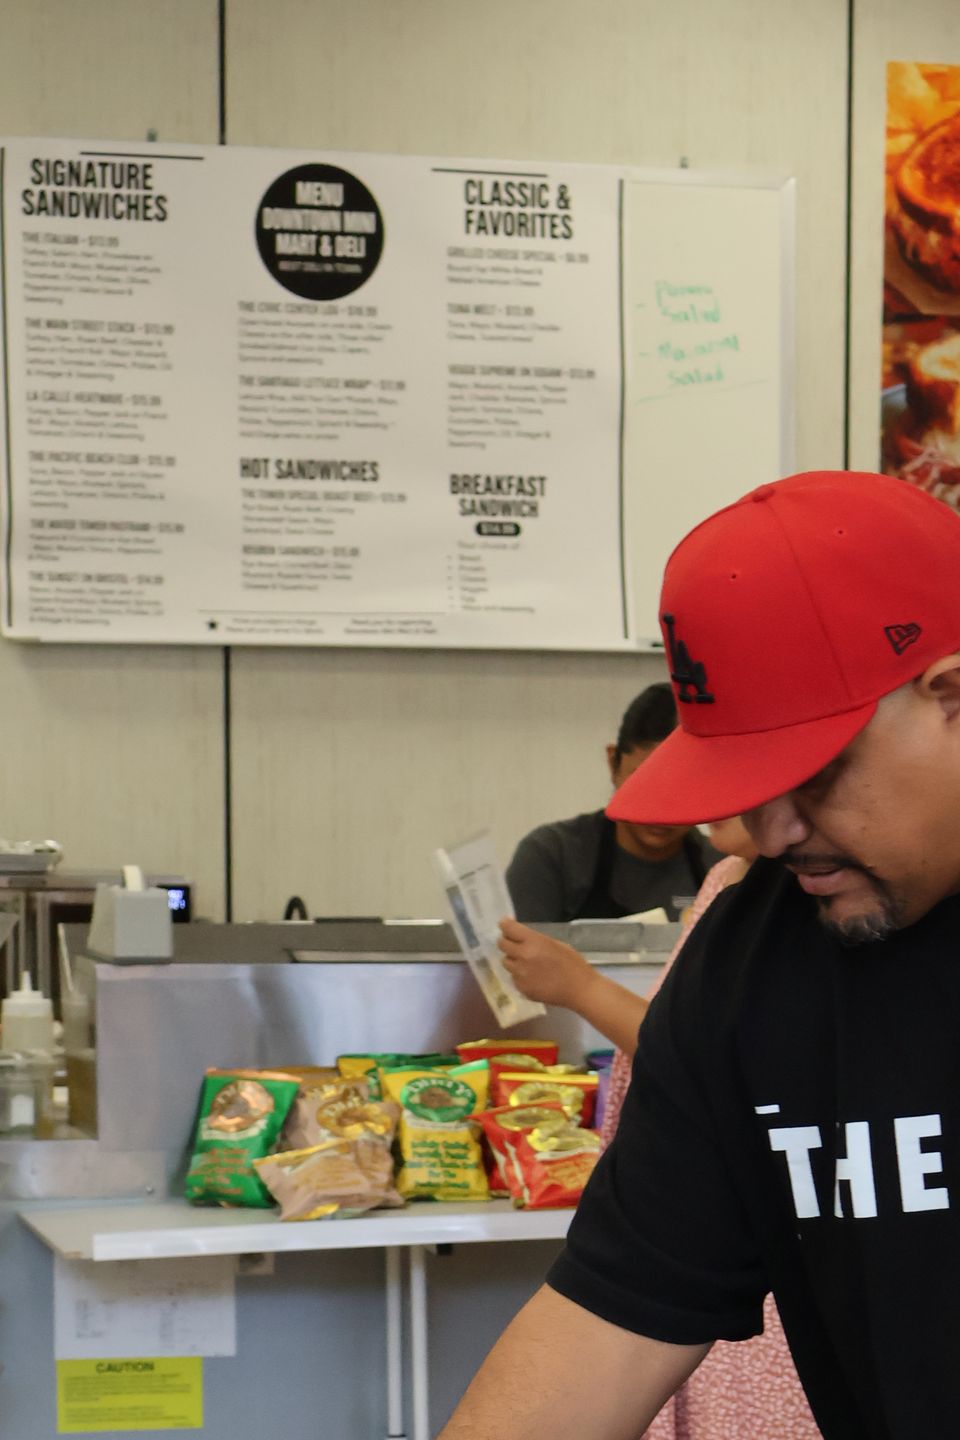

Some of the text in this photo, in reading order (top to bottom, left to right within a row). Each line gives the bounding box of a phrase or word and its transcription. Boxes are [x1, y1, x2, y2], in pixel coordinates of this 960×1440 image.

[31, 158, 153, 190] SIGNATURE
[21, 189, 168, 222] SANDWICHES
[295, 181, 344, 207] MENU
[464, 178, 571, 210] CLASSIC &
[464, 209, 573, 239] FAVORITES
[275, 232, 367, 258] MART & DELI
[240, 457, 380, 482] HOT SANDWICHES
[450, 474, 547, 496] BREAKFAST
[459, 499, 539, 517] SANDWICH
[663, 614, 715, 704] LA
[768, 1114, 950, 1219] THE
[96, 1362, 155, 1374] CAUTION
